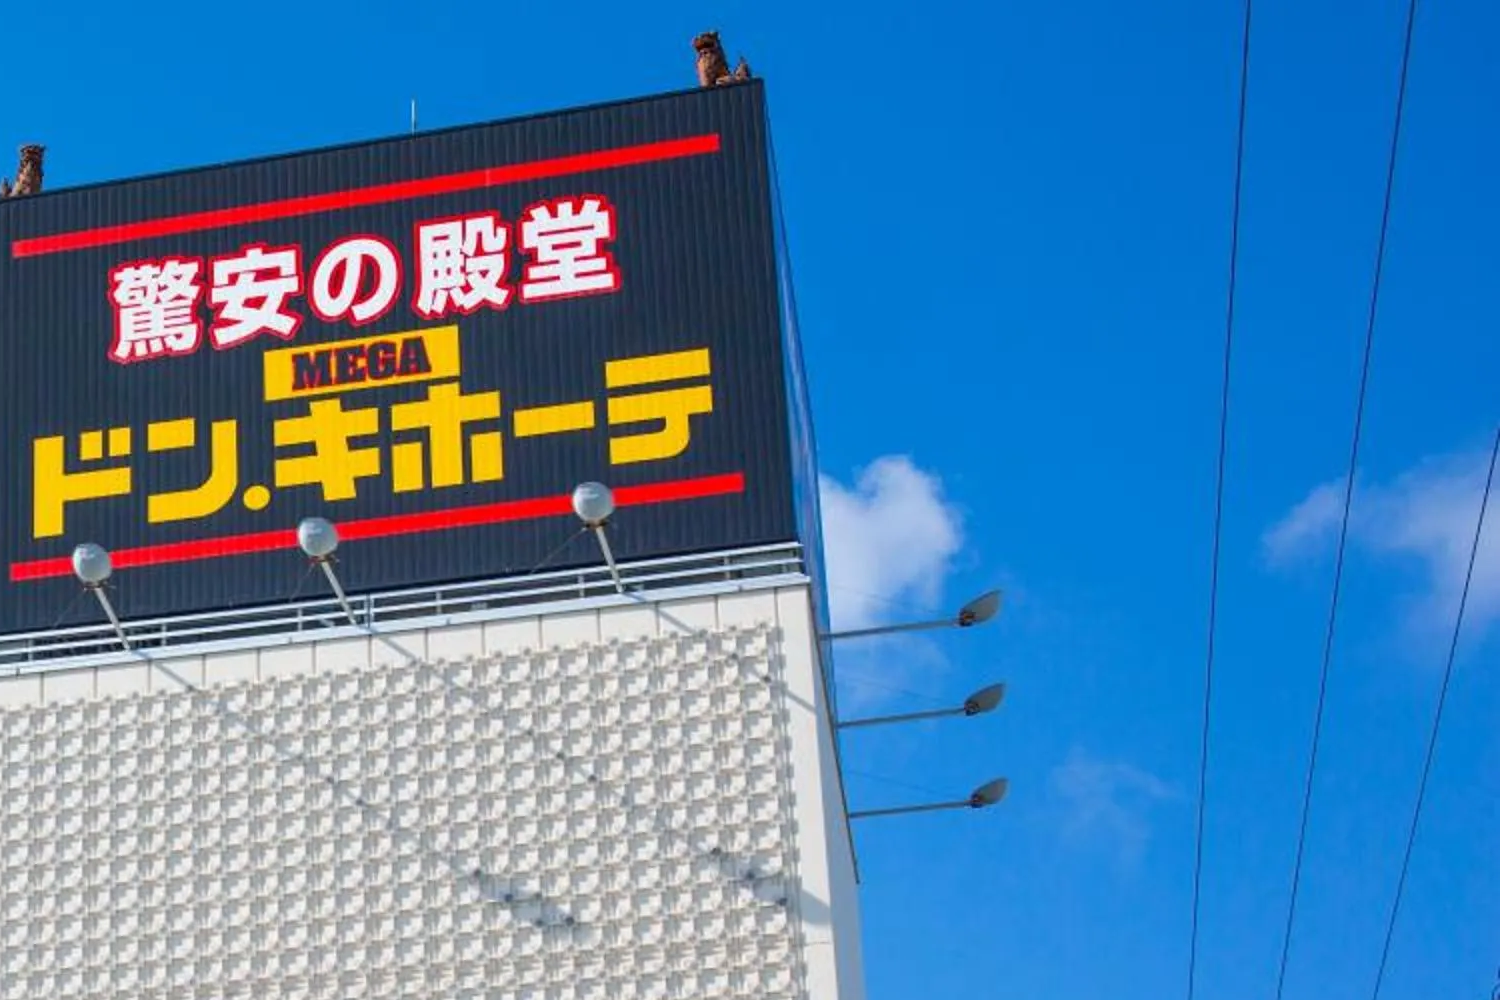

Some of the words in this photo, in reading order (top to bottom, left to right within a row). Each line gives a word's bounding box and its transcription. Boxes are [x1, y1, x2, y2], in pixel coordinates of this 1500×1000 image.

[110, 196, 619, 362] 驚安の殿堂
[291, 336, 432, 391] MEGA
